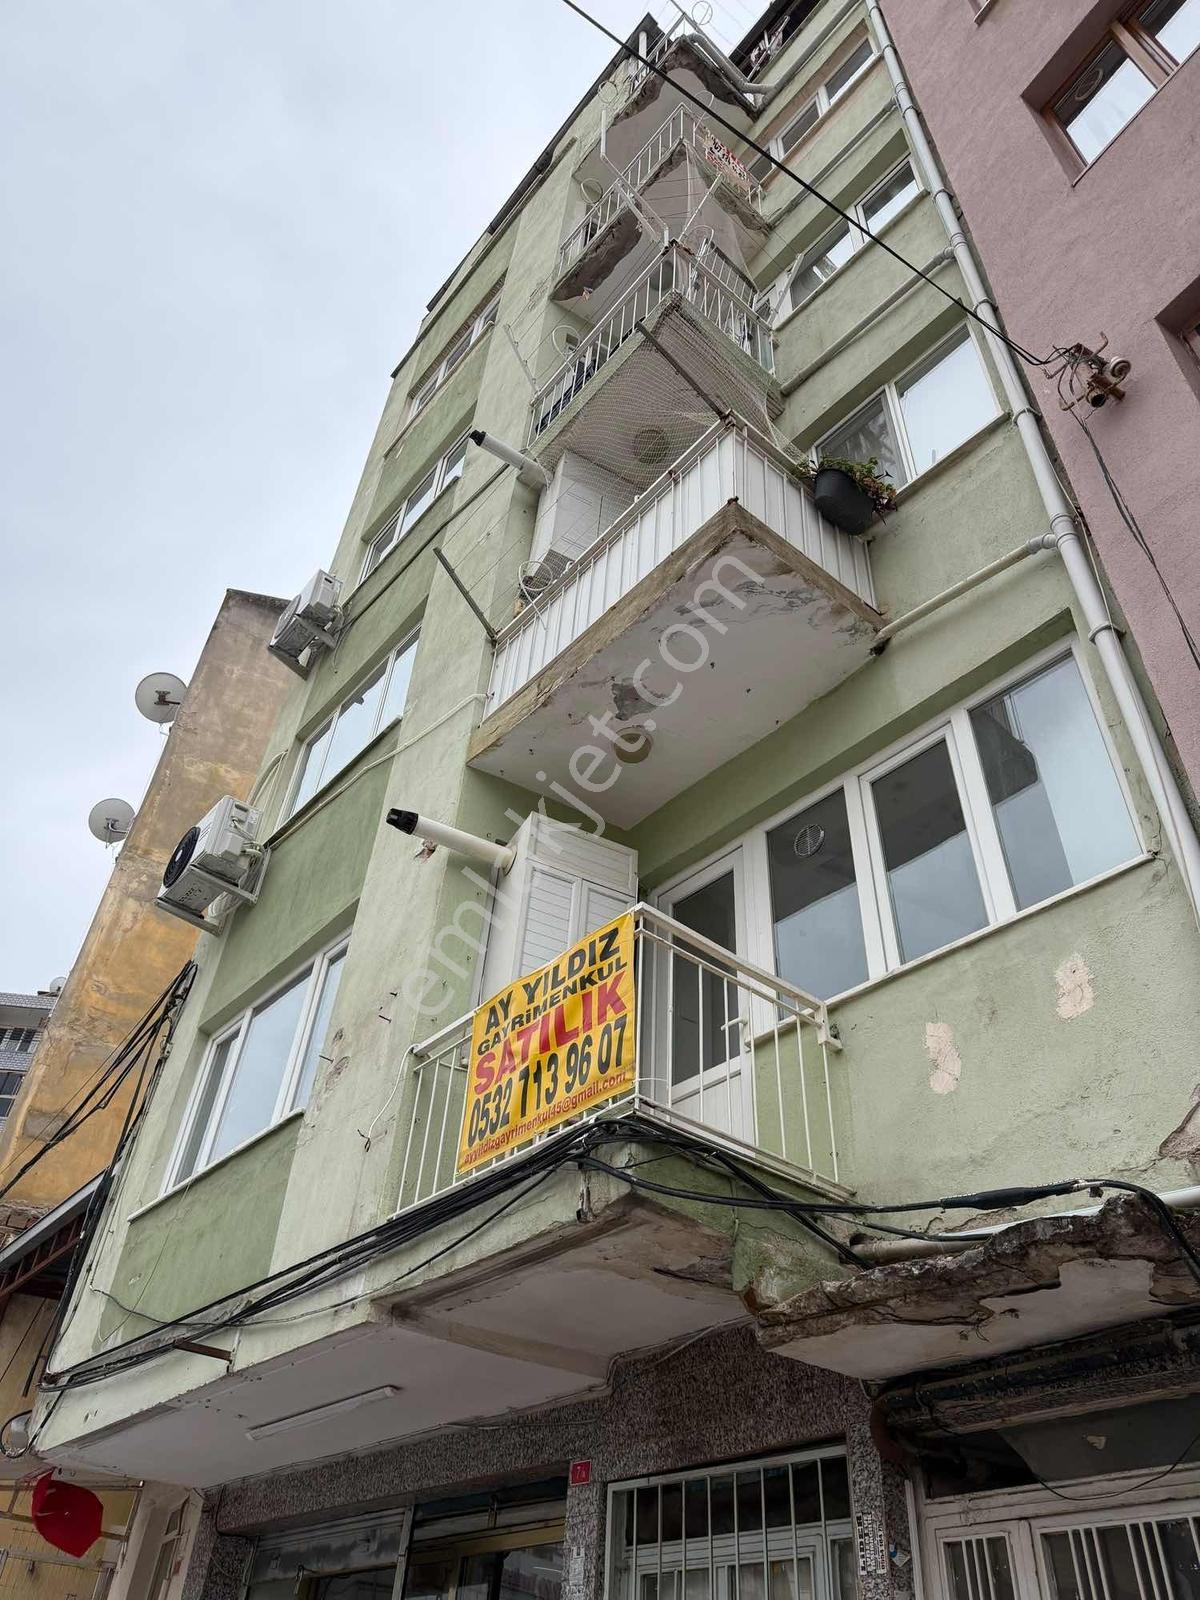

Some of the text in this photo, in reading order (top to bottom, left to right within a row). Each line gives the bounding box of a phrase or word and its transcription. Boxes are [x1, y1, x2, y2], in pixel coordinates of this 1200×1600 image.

[474, 971, 627, 1095] SATILIK
[484, 928, 620, 1036] AY YILDIZ
[464, 1071, 626, 1165] ayyildizgayrimenkul45@gmail.com
[467, 1014, 628, 1148] 0532 713 96 07
